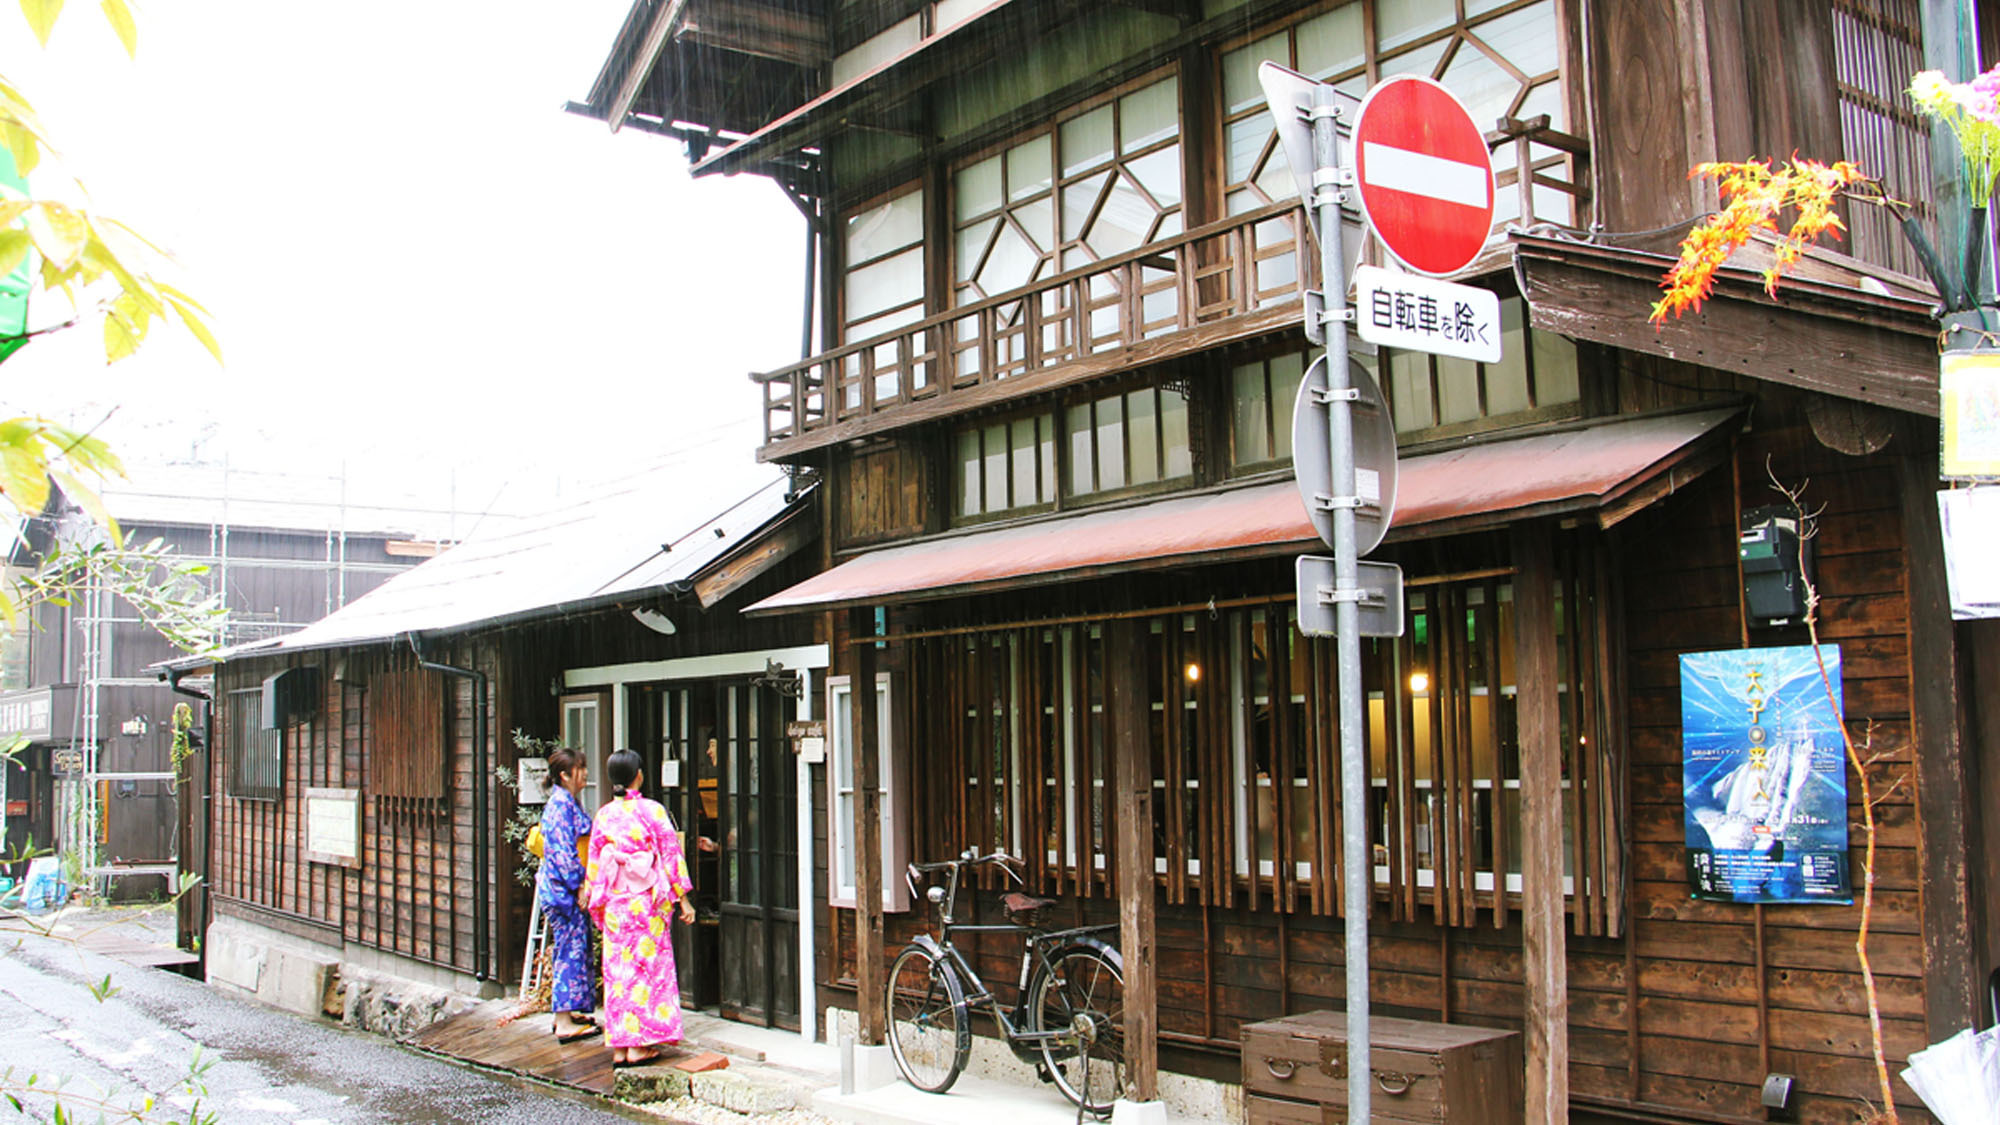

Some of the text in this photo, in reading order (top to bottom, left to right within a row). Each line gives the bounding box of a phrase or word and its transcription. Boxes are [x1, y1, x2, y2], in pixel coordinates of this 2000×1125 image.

[1373, 288, 1489, 345] 自転車を除く
